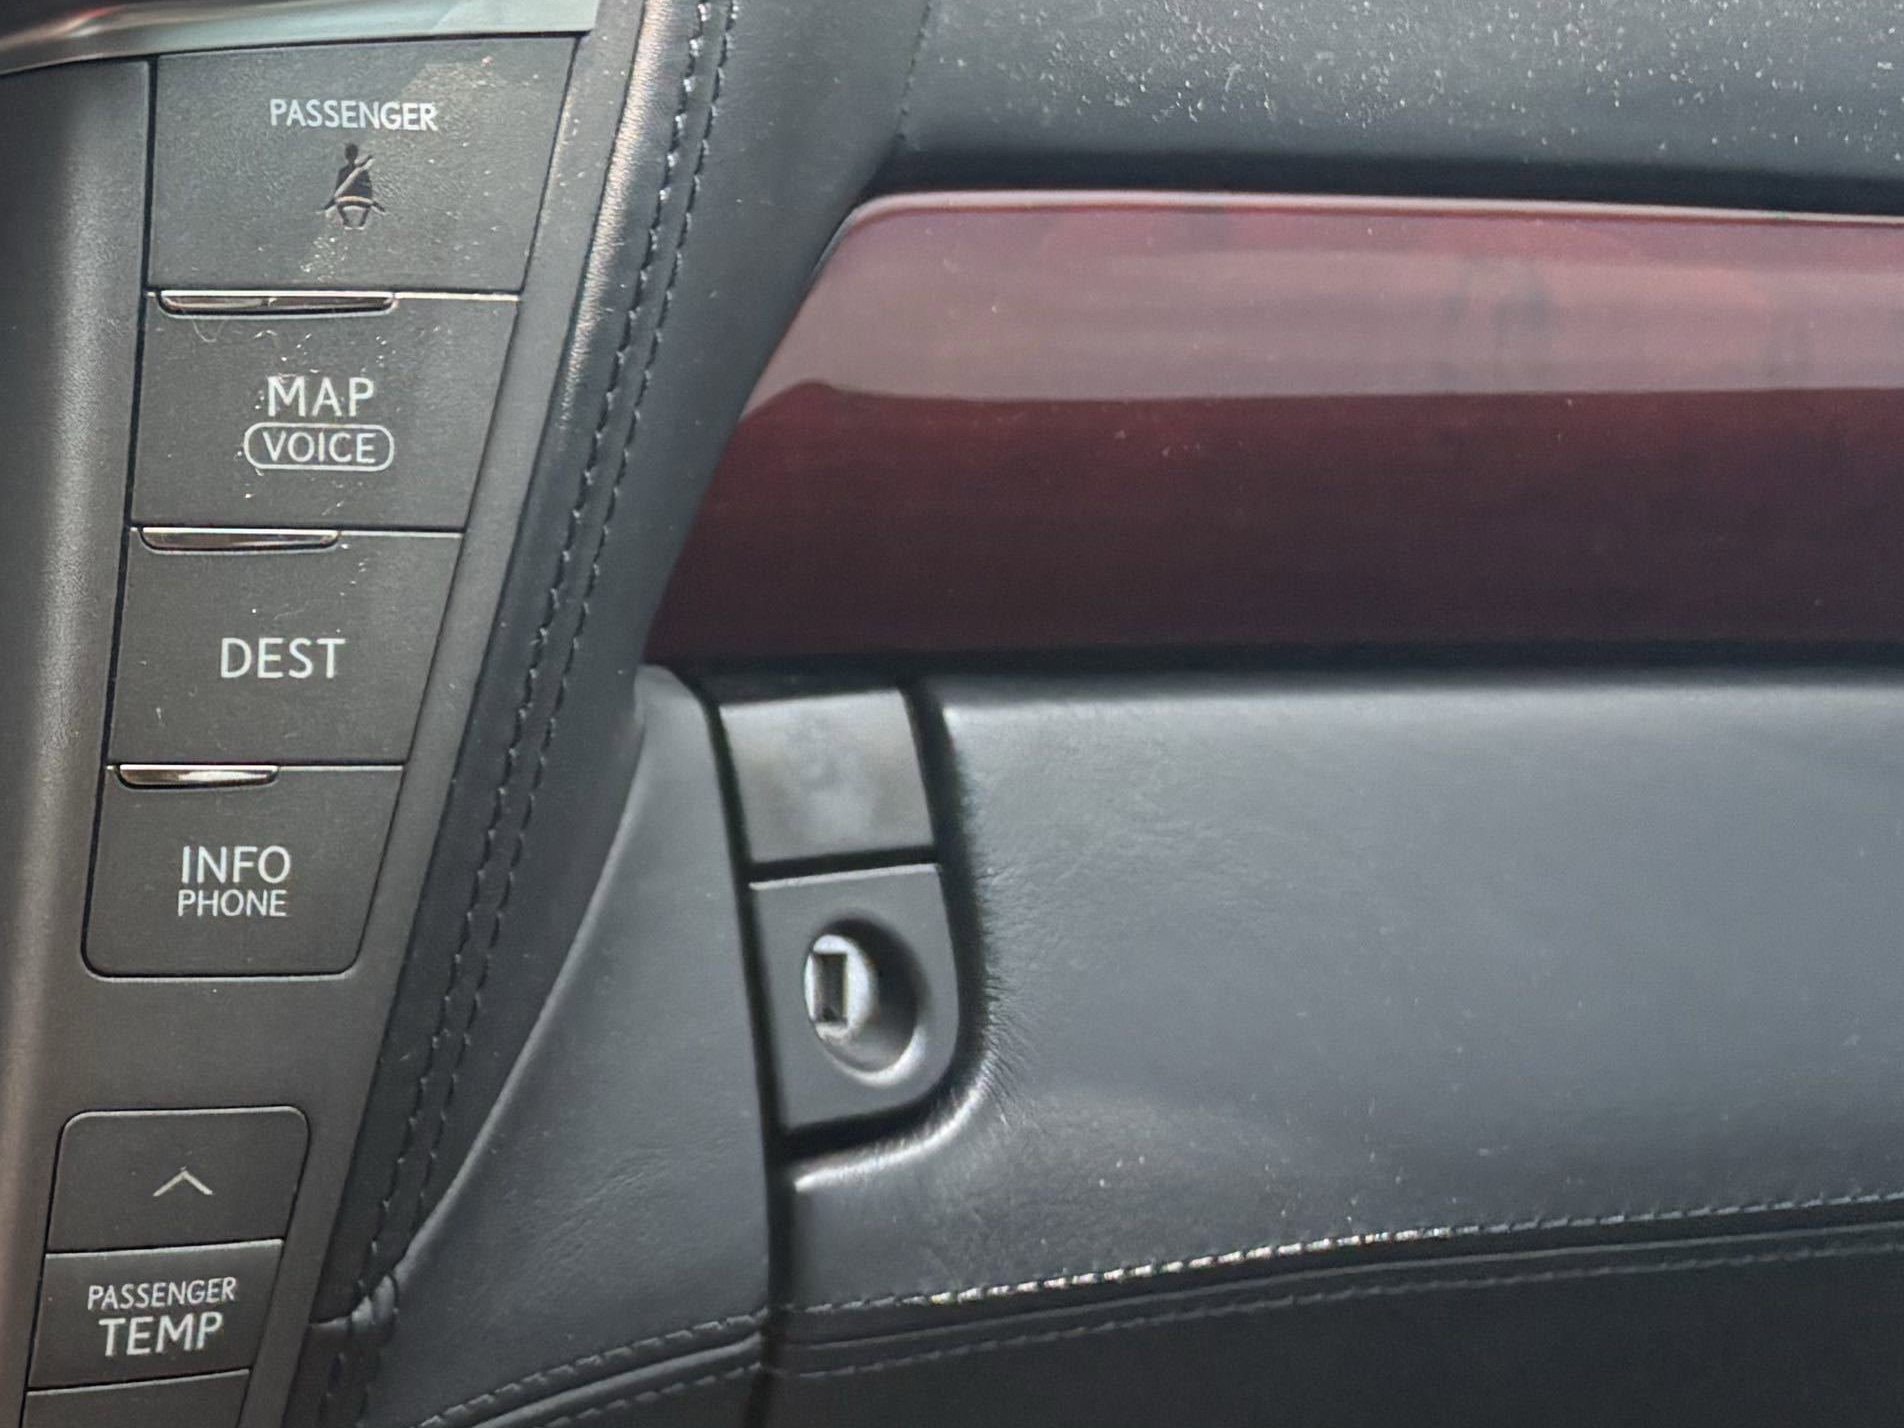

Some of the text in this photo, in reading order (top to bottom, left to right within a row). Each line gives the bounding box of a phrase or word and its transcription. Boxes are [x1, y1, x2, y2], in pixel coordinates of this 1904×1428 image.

[270, 98, 438, 132] PASSENGER
[266, 376, 375, 418] MAP
[263, 430, 376, 464] VOICE
[220, 638, 346, 679] DEST
[181, 845, 291, 884] INFO
[177, 890, 287, 917] PHONE
[87, 1277, 236, 1311] PASSENGER
[98, 1311, 224, 1357] TEMP
